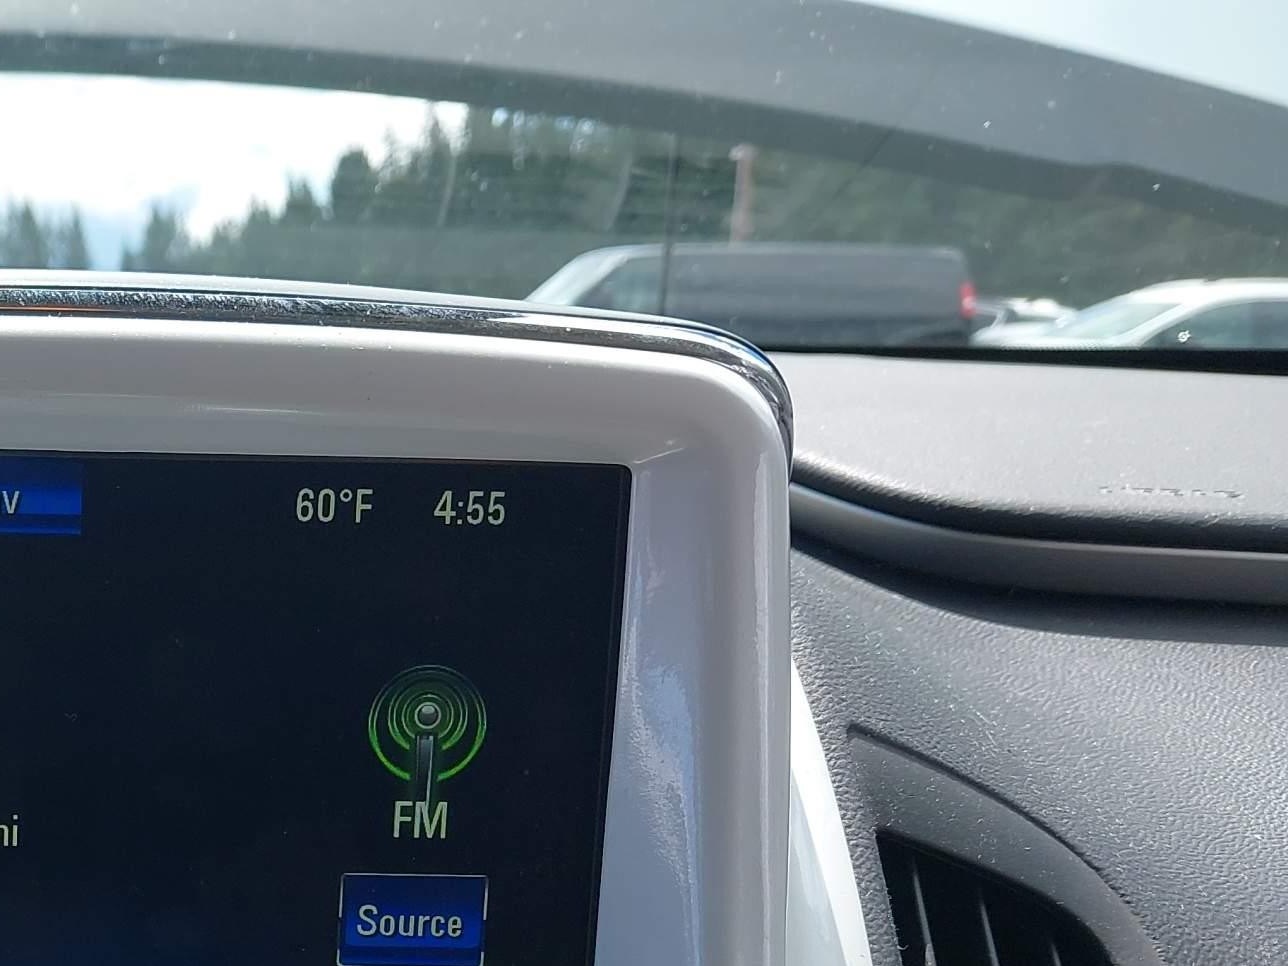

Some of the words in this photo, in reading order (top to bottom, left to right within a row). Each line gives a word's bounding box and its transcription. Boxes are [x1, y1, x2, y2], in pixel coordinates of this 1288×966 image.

[296, 488, 373, 523] 60°F
[434, 491, 505, 525] 4:55
[393, 801, 448, 839] FM
[357, 905, 462, 937] Source
